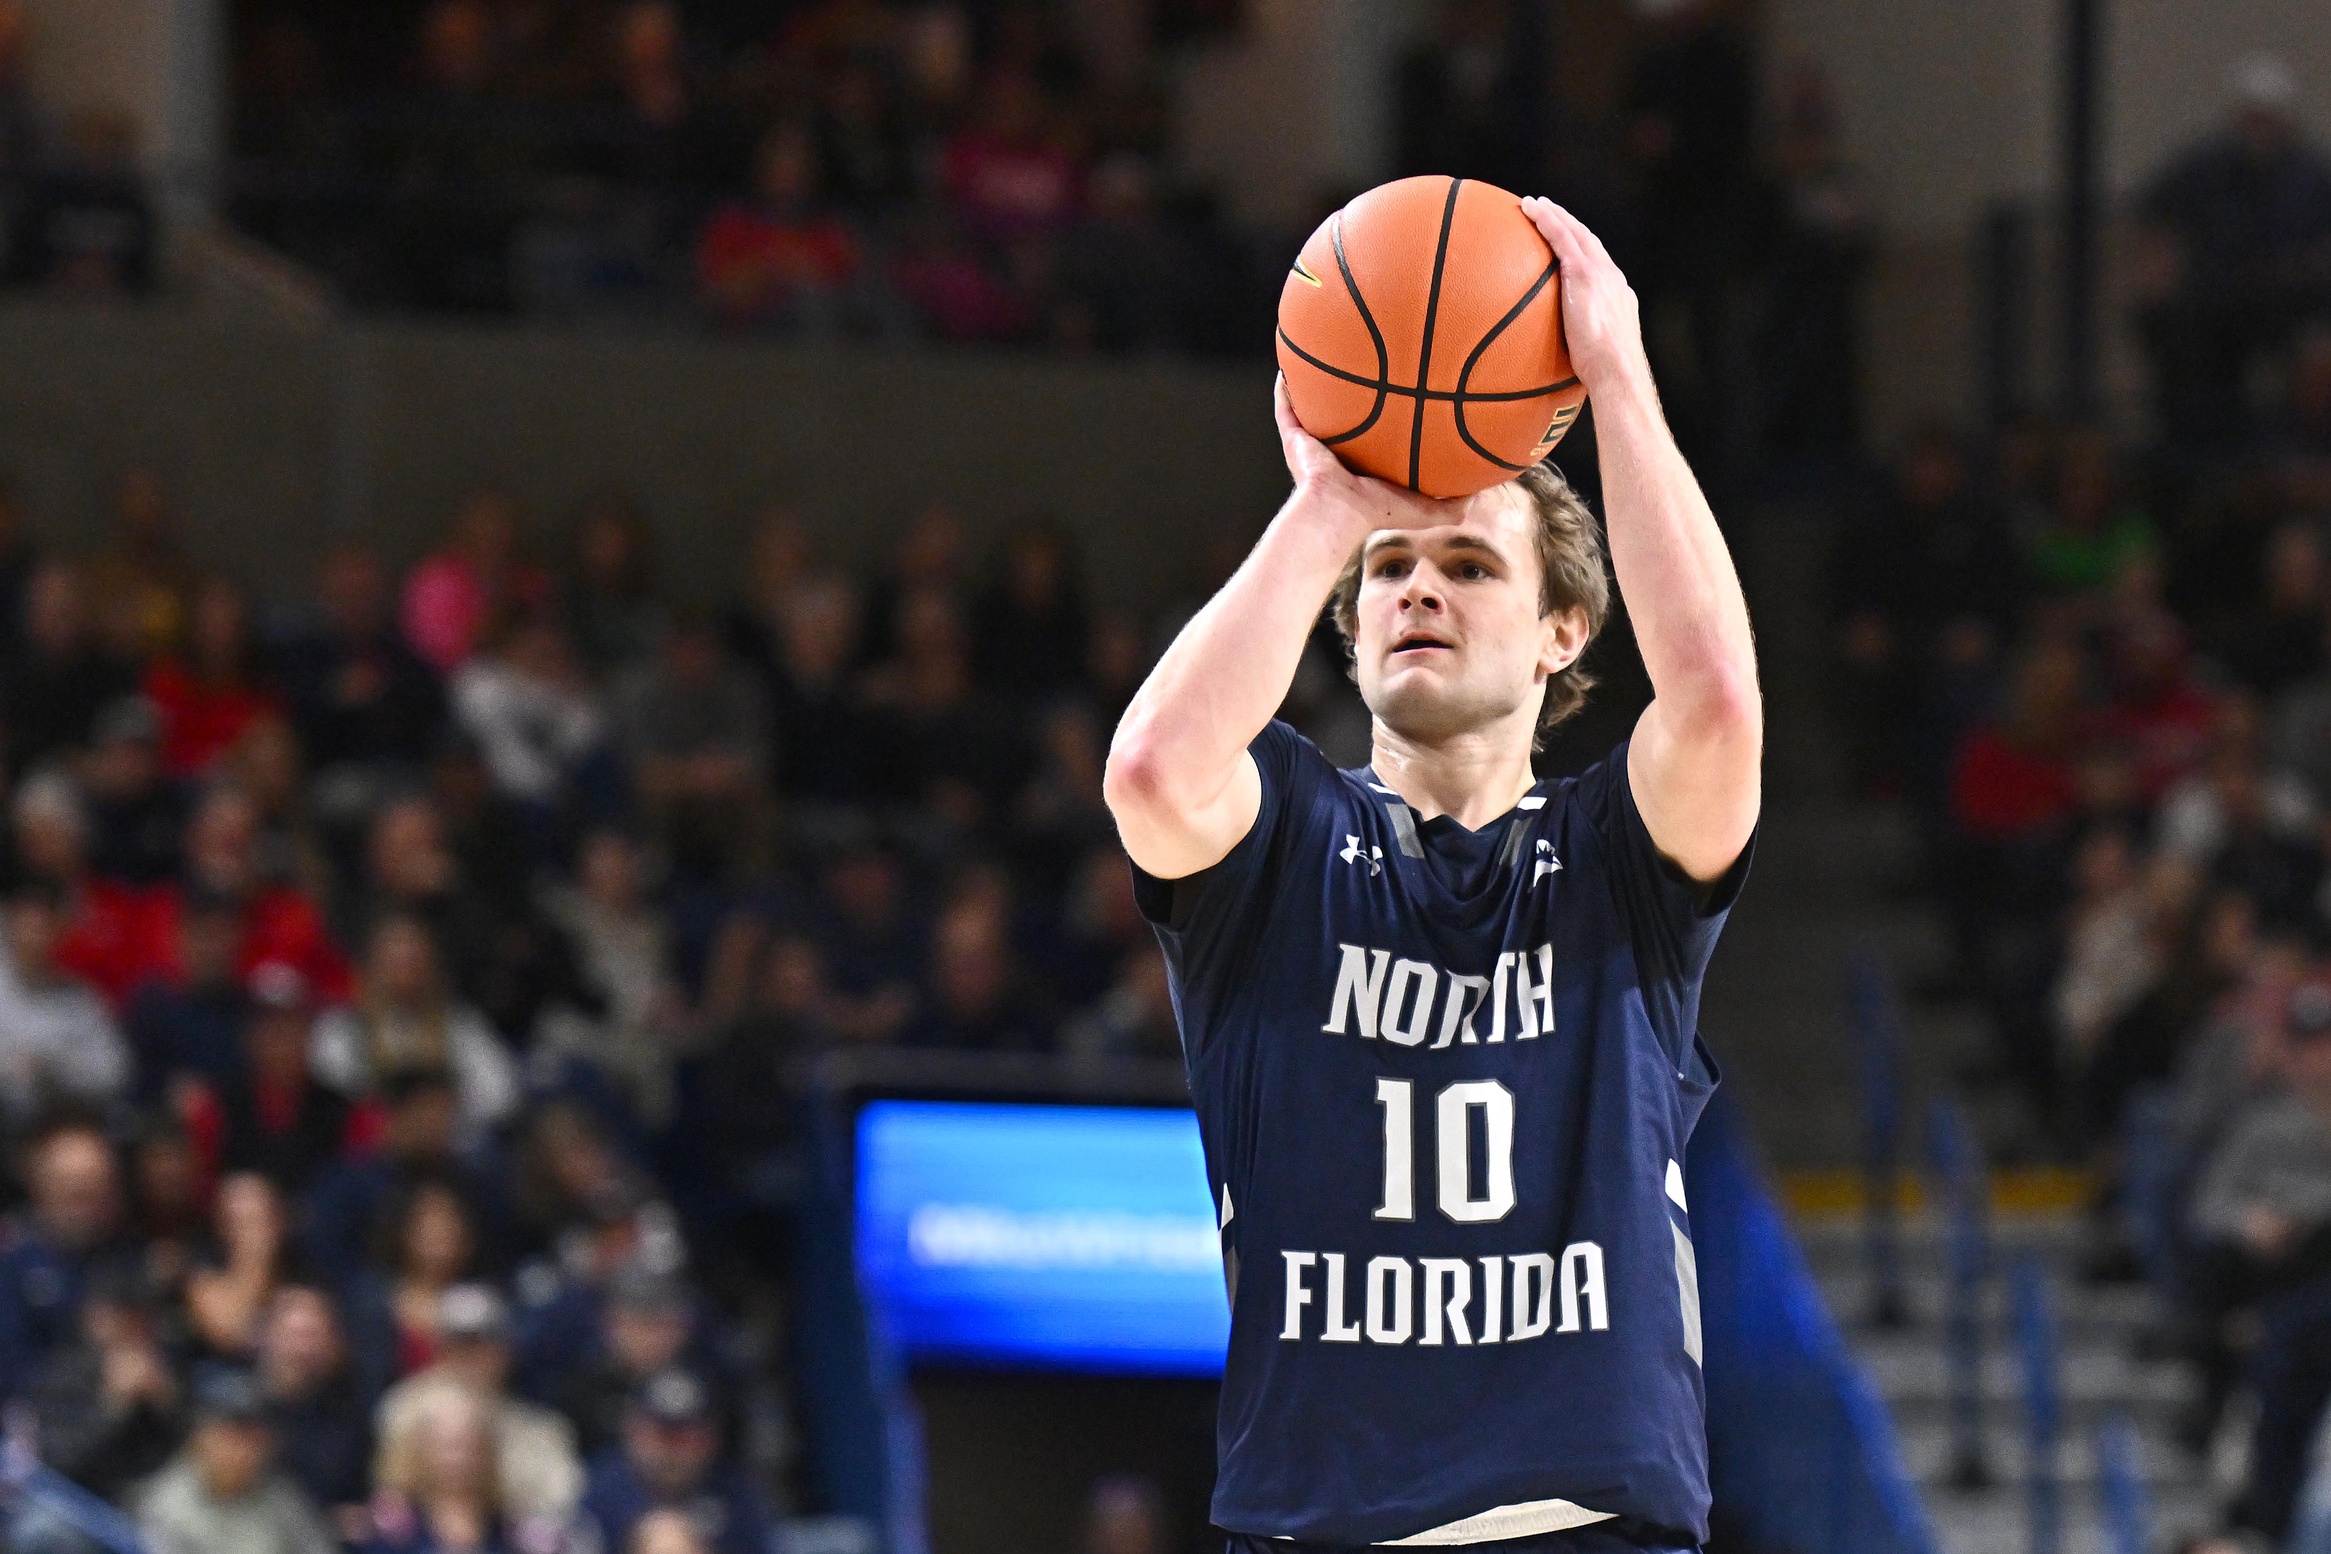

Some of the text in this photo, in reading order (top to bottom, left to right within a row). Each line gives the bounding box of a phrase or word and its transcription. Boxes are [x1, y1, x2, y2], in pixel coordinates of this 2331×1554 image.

[1321, 942, 1555, 1049] NORTH
[1372, 1077, 1516, 1223] 10
[1279, 1241, 1609, 1346] FLORIDA
